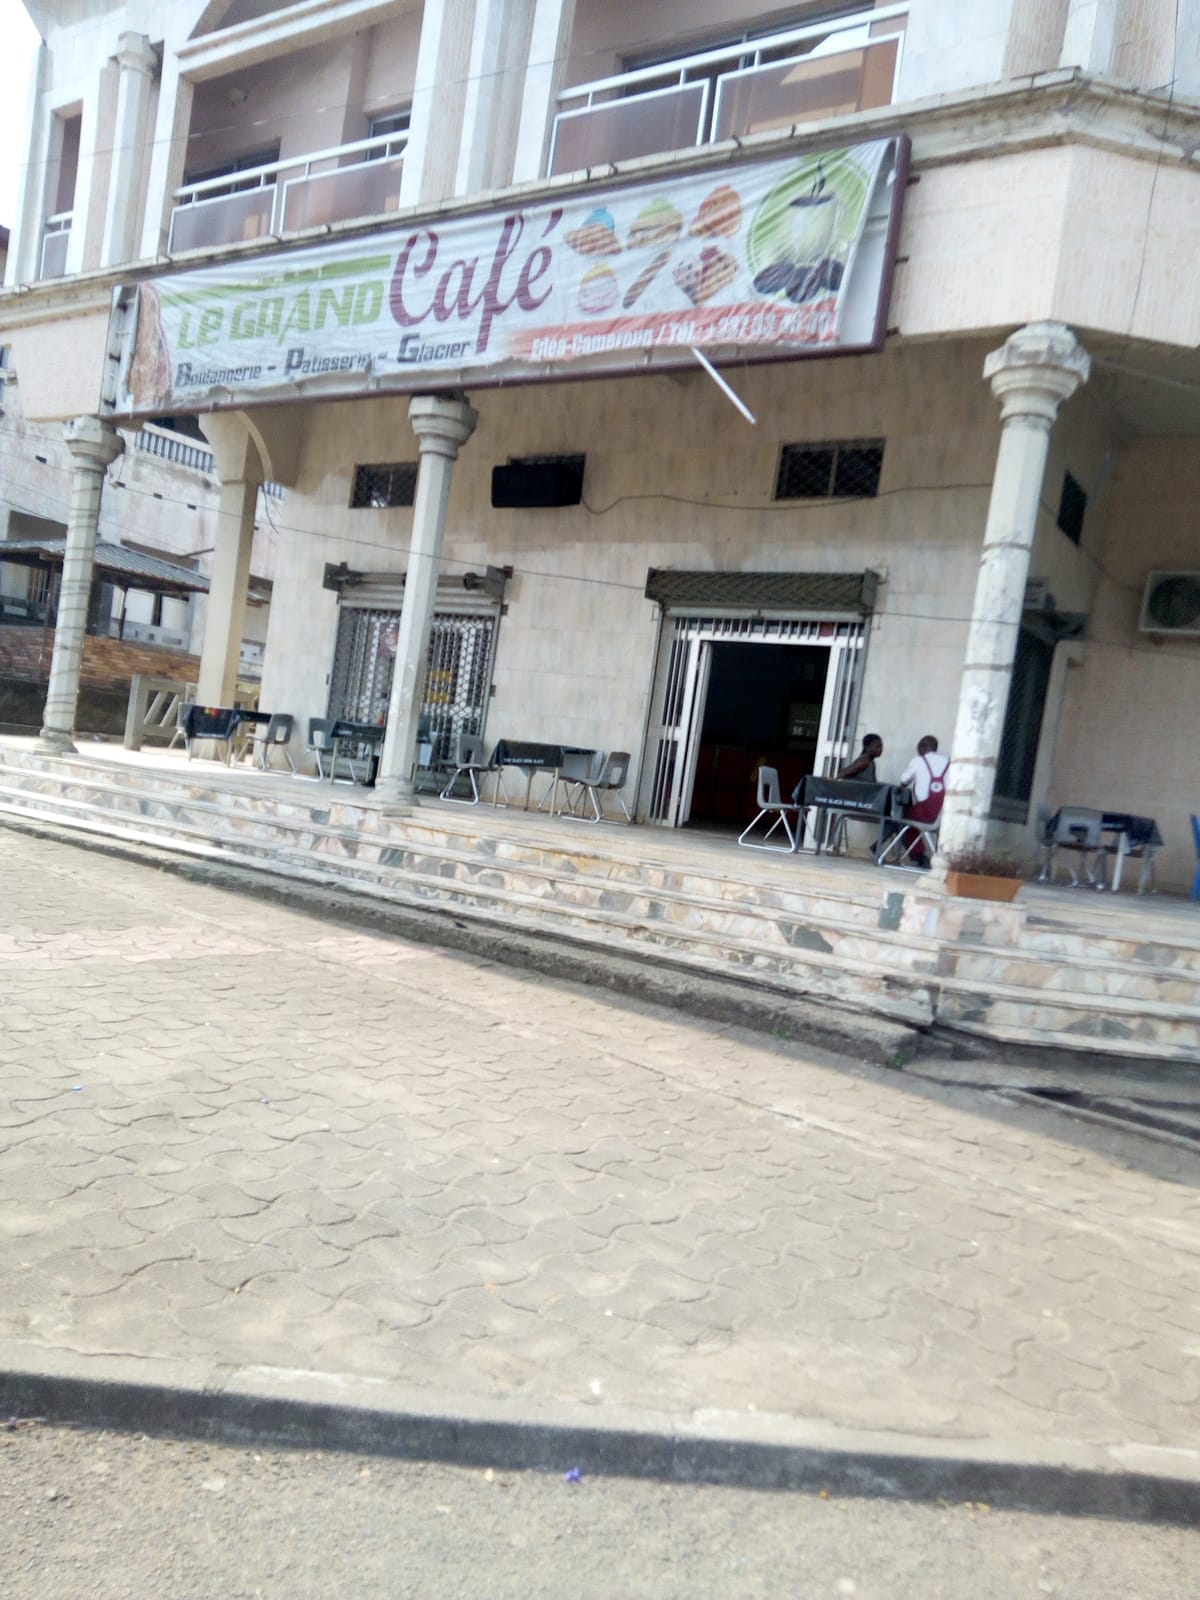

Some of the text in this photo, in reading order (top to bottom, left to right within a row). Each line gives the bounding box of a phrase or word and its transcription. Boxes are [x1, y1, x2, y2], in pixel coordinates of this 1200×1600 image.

[229, 281, 385, 347] GRAND
[389, 208, 563, 354] Café
[397, 332, 471, 363] Glacier
